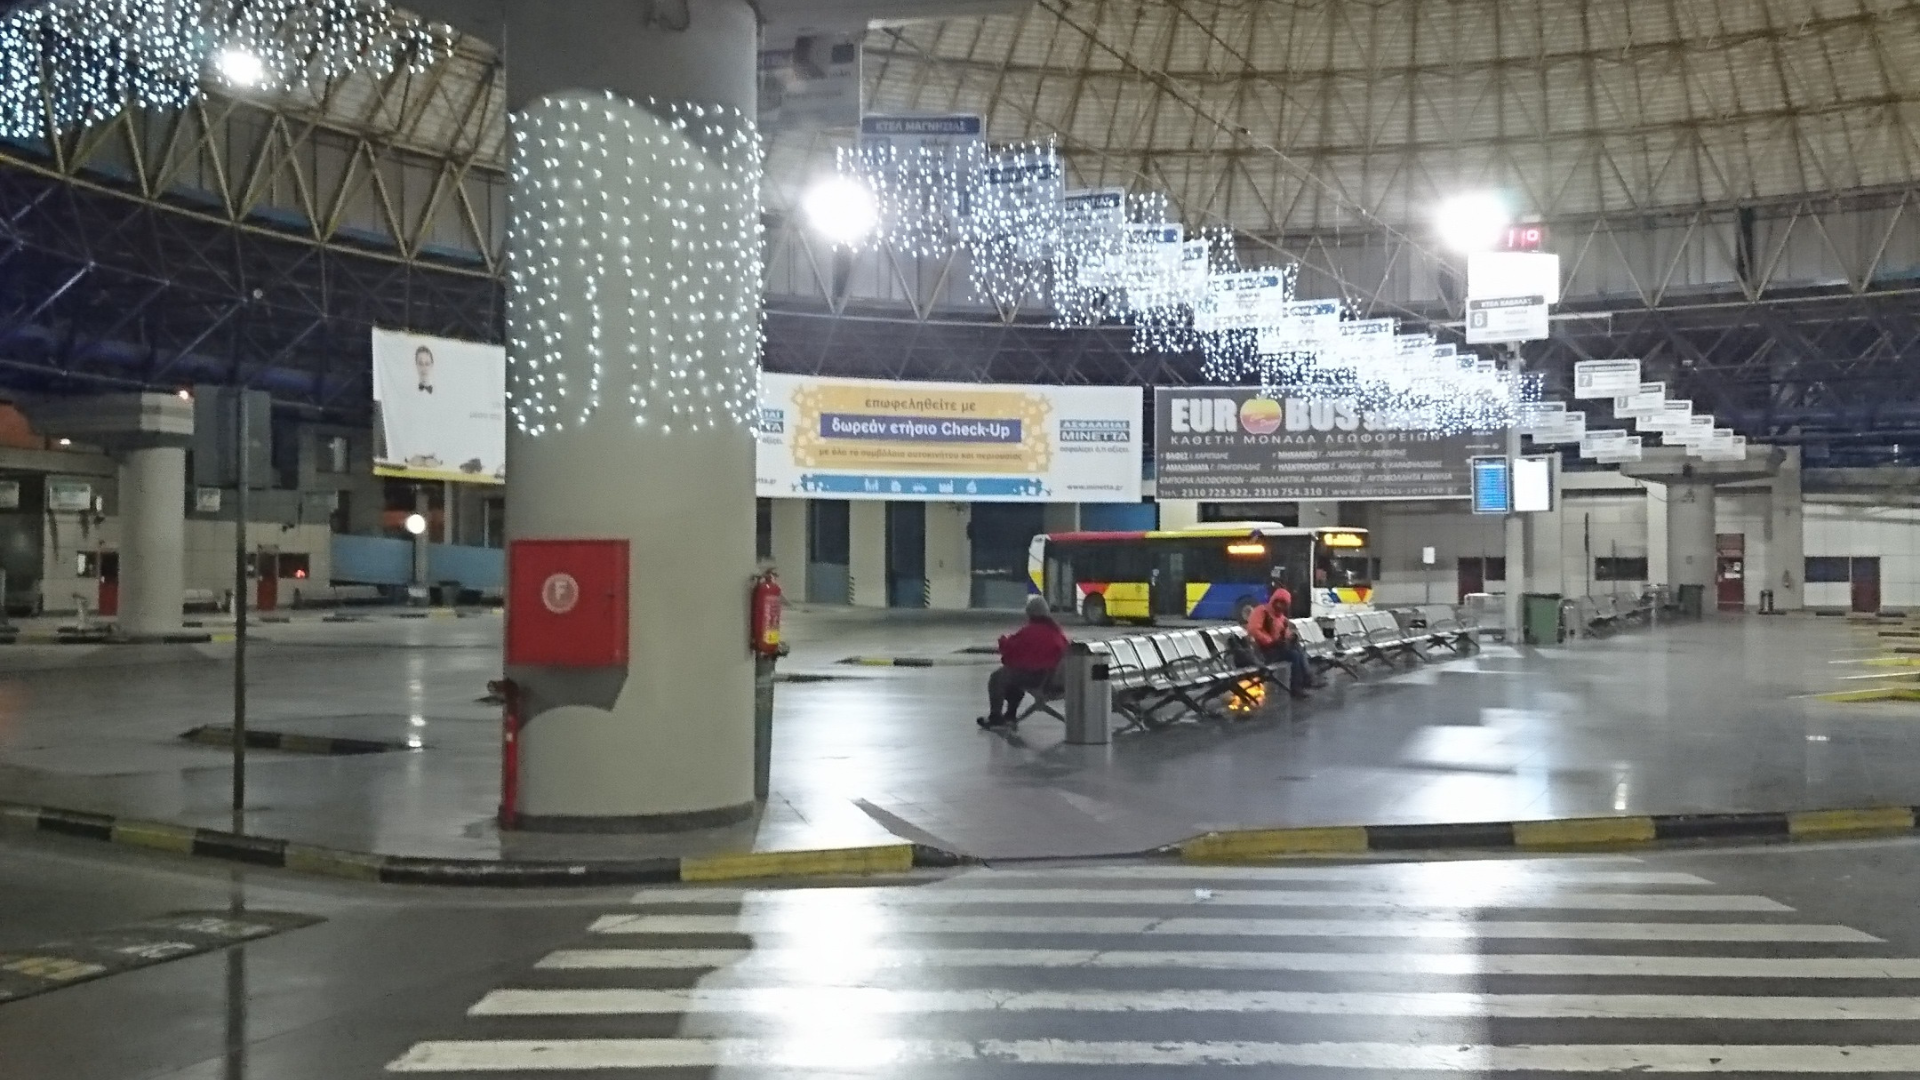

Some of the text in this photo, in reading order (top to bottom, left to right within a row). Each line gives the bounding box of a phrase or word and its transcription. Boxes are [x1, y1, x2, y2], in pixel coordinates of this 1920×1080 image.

[875, 120, 966, 131] ΚΤΕΛ ΜΑΓΝΗΣΙΑΣ
[1474, 312, 1484, 328] 6
[1582, 375, 1589, 387] 7
[865, 398, 976, 413] επωφεληθείτε με
[832, 417, 1010, 439] δωρεάν ετήσιο Check-Up
[1061, 431, 1128, 441] MINETTA
[1171, 432, 1440, 445] ΚΑΘΕΤΗ ΜΟΝΑΔΑ ΛΕΩΦΟΡΕΙΩΝ
[1181, 488, 1206, 498] 2310
[1208, 488, 1251, 498] 722.922,
[1254, 488, 1279, 498] 2310
[1281, 487, 1322, 497] 754.310
